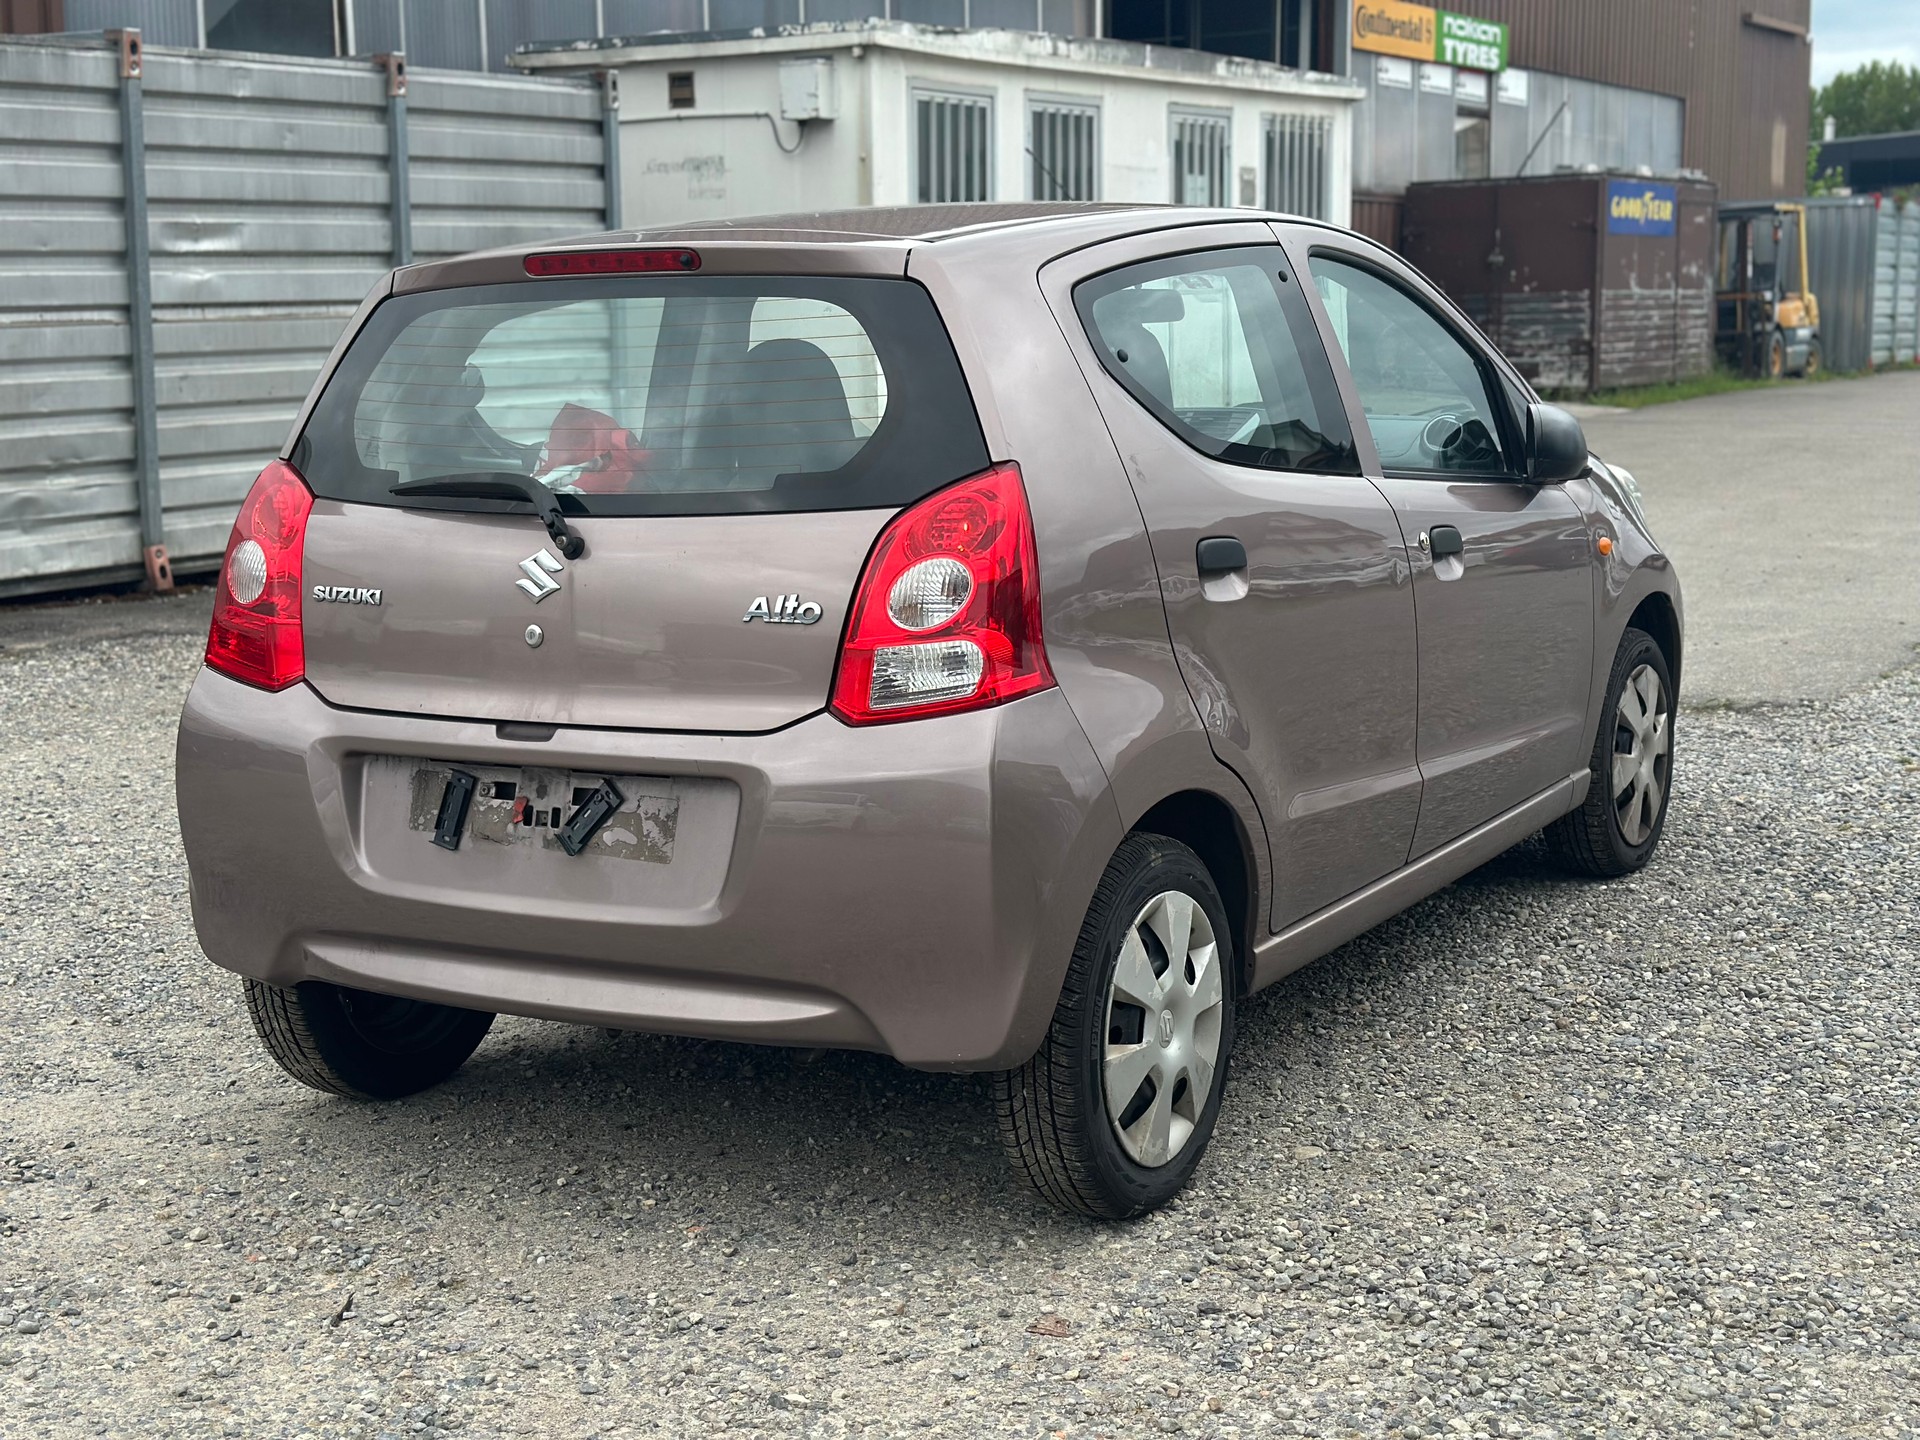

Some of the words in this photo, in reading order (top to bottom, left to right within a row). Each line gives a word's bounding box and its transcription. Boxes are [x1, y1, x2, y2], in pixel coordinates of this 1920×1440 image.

[1356, 5, 1423, 43] Continental
[1443, 38, 1500, 71] TYRES
[312, 585, 382, 606] SUZUKI
[742, 593, 823, 625] Alto
